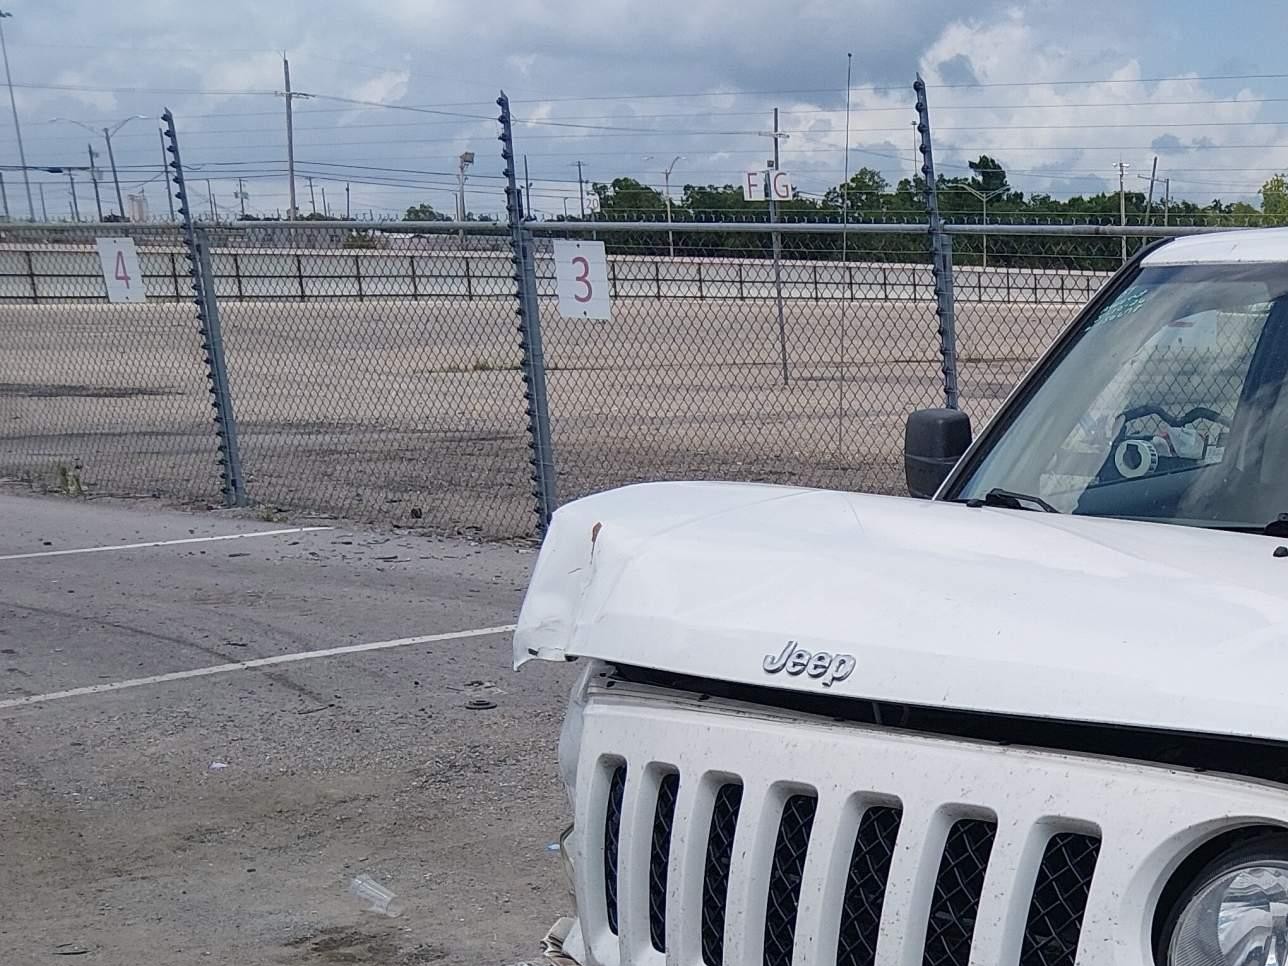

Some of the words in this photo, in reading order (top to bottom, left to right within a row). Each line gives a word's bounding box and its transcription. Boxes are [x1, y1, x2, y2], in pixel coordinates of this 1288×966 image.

[746, 172, 758, 199] F
[773, 172, 790, 199] G
[115, 250, 131, 290] 4
[571, 256, 593, 303] 3
[763, 640, 856, 687] Jeep
